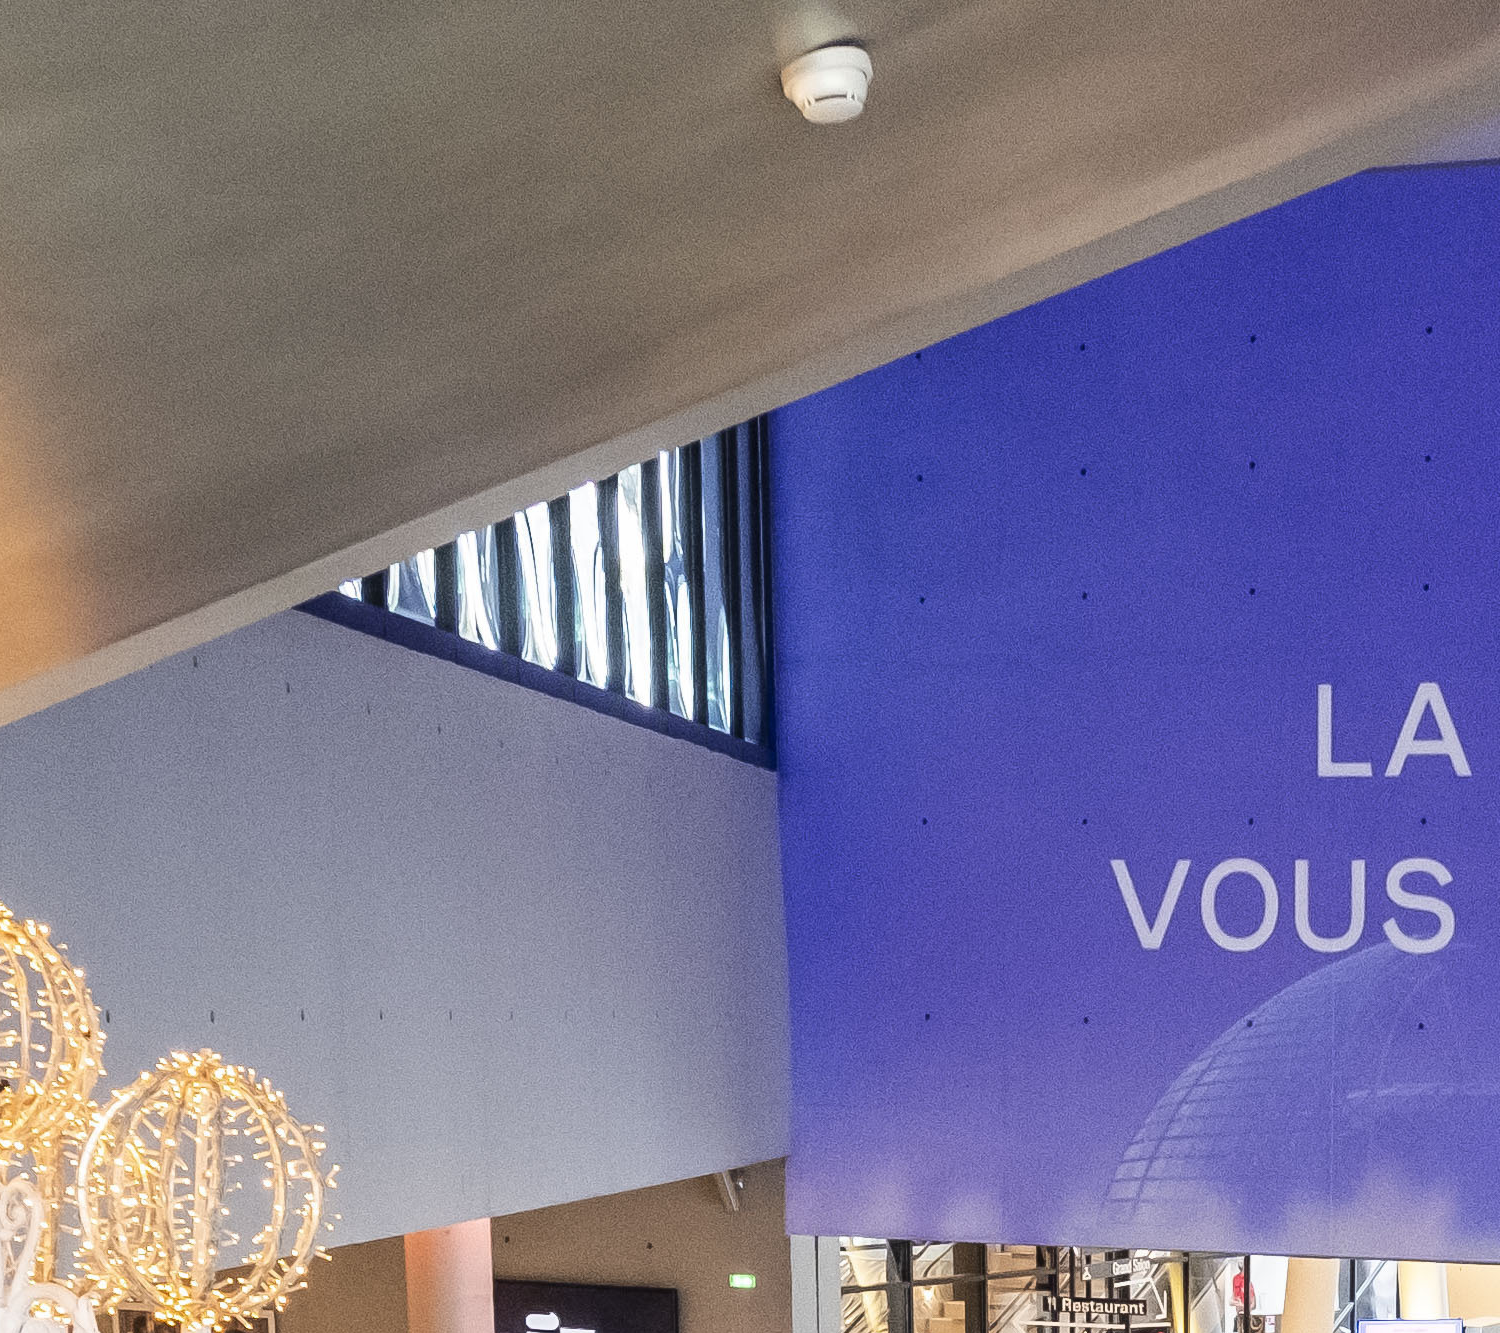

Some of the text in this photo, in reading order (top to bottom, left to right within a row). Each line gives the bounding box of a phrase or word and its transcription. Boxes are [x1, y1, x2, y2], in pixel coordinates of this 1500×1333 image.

[1317, 681, 1472, 778] LA
[1110, 857, 1456, 955] VOUS
[1061, 1297, 1146, 1315] Restaurant
